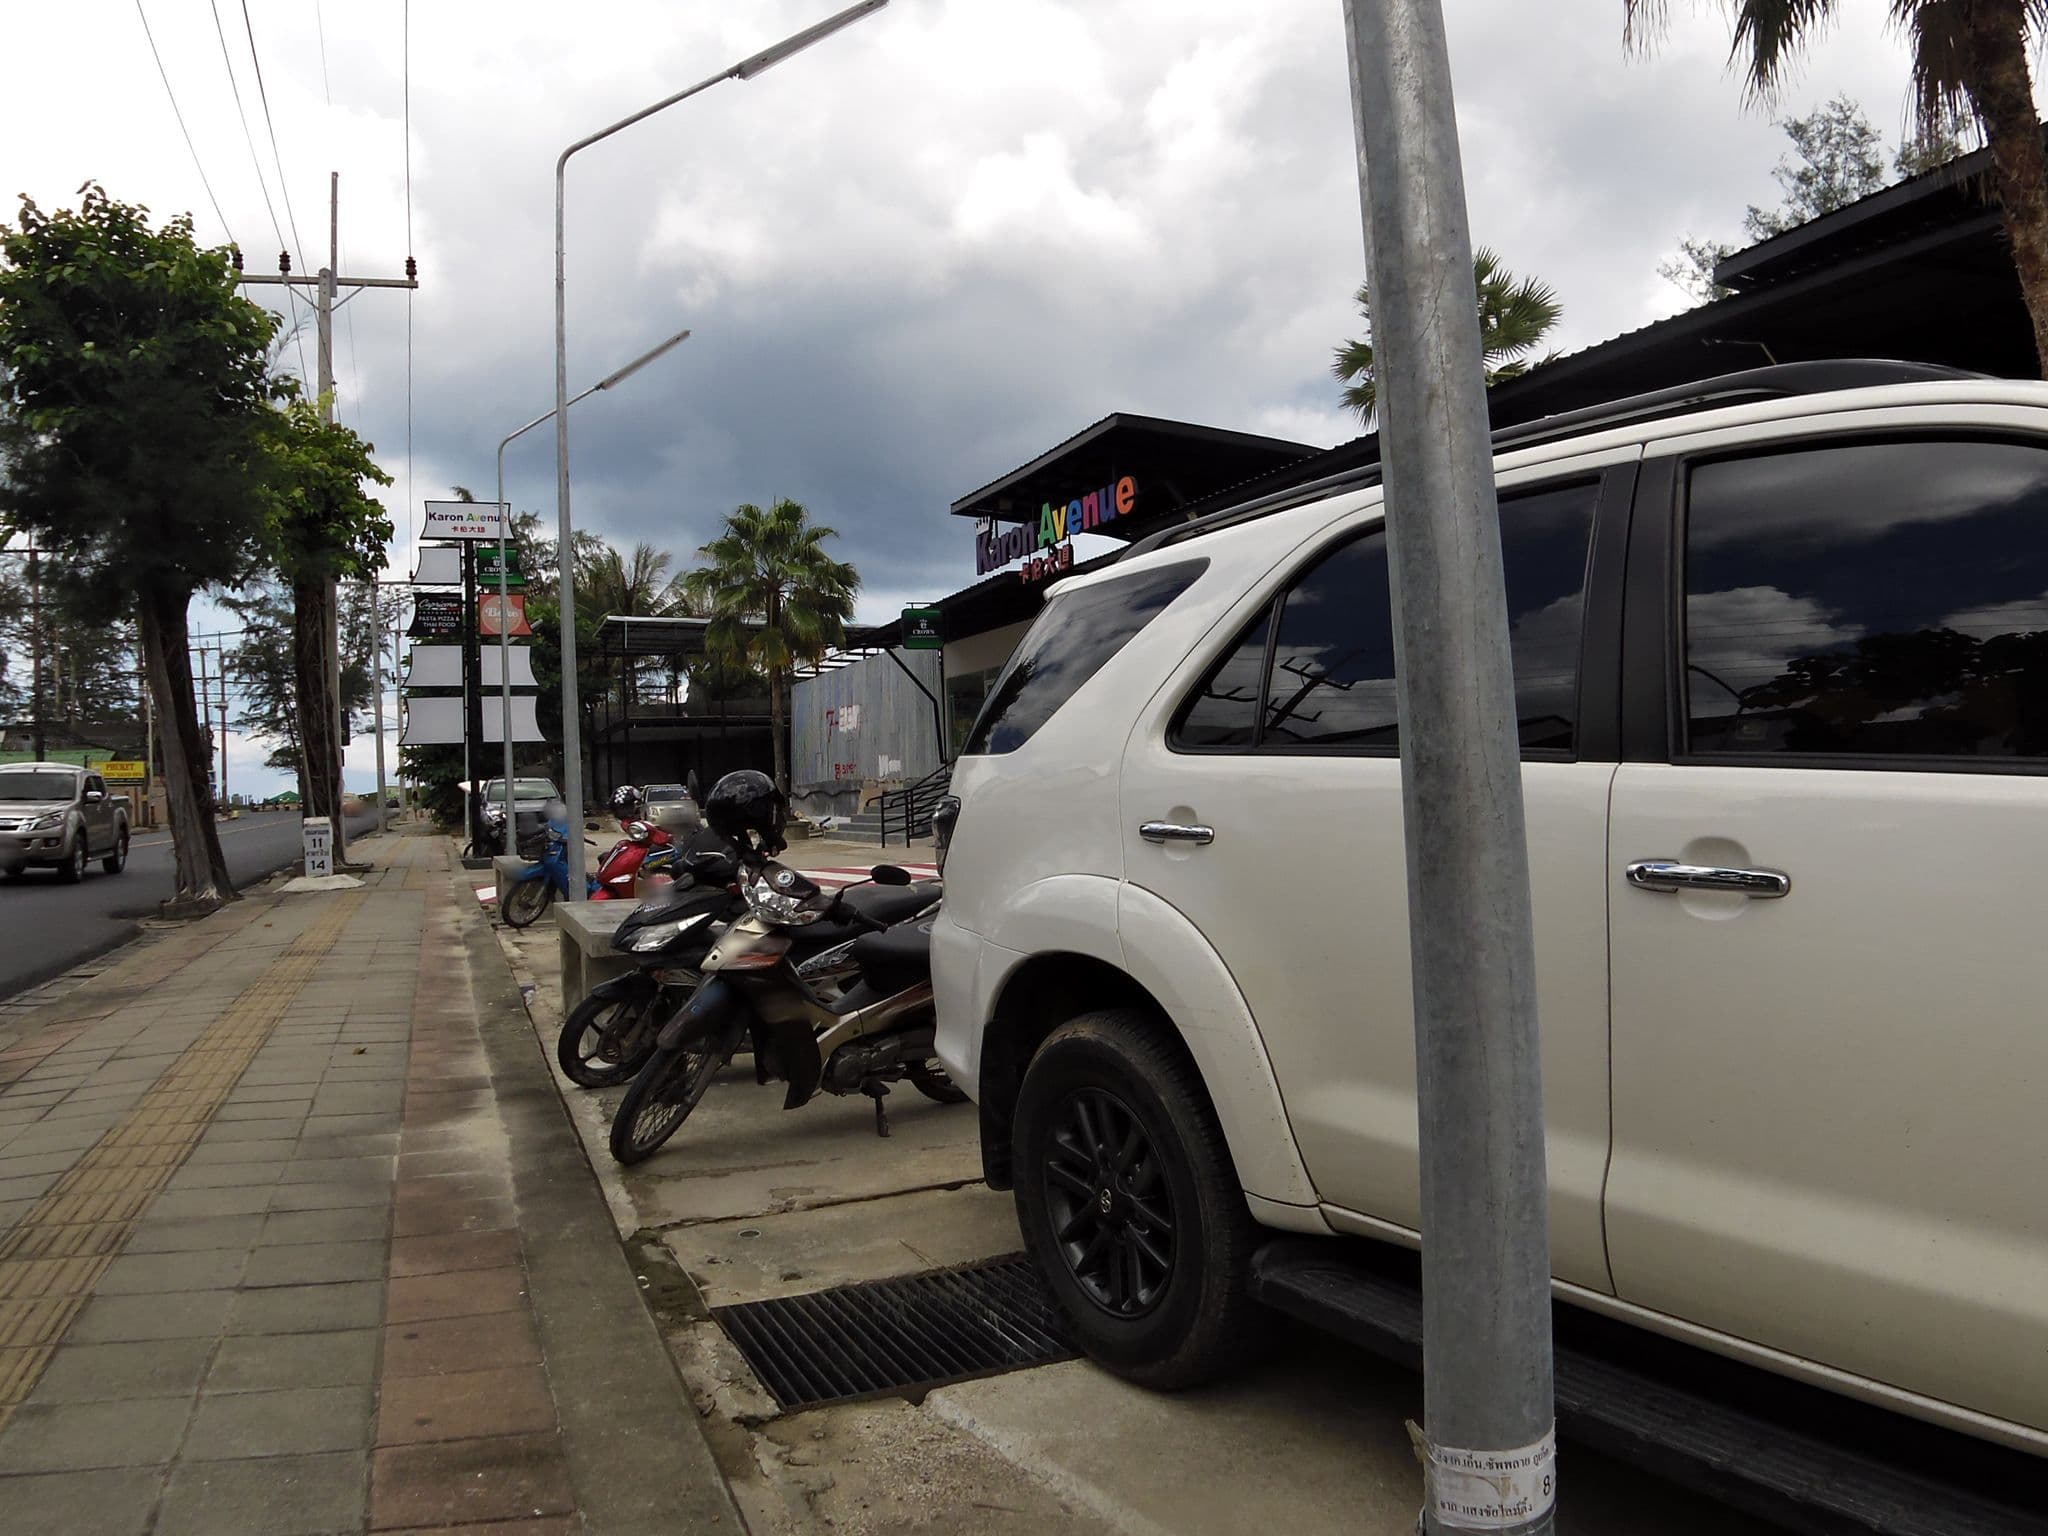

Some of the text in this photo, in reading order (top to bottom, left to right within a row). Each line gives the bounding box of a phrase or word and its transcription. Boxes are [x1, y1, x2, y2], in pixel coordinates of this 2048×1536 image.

[428, 511, 464, 522] Karon
[976, 475, 1135, 576] Karon Avenue
[312, 838, 323, 849] 11
[311, 860, 325, 870] 14
[1543, 1475, 1551, 1496] 8
